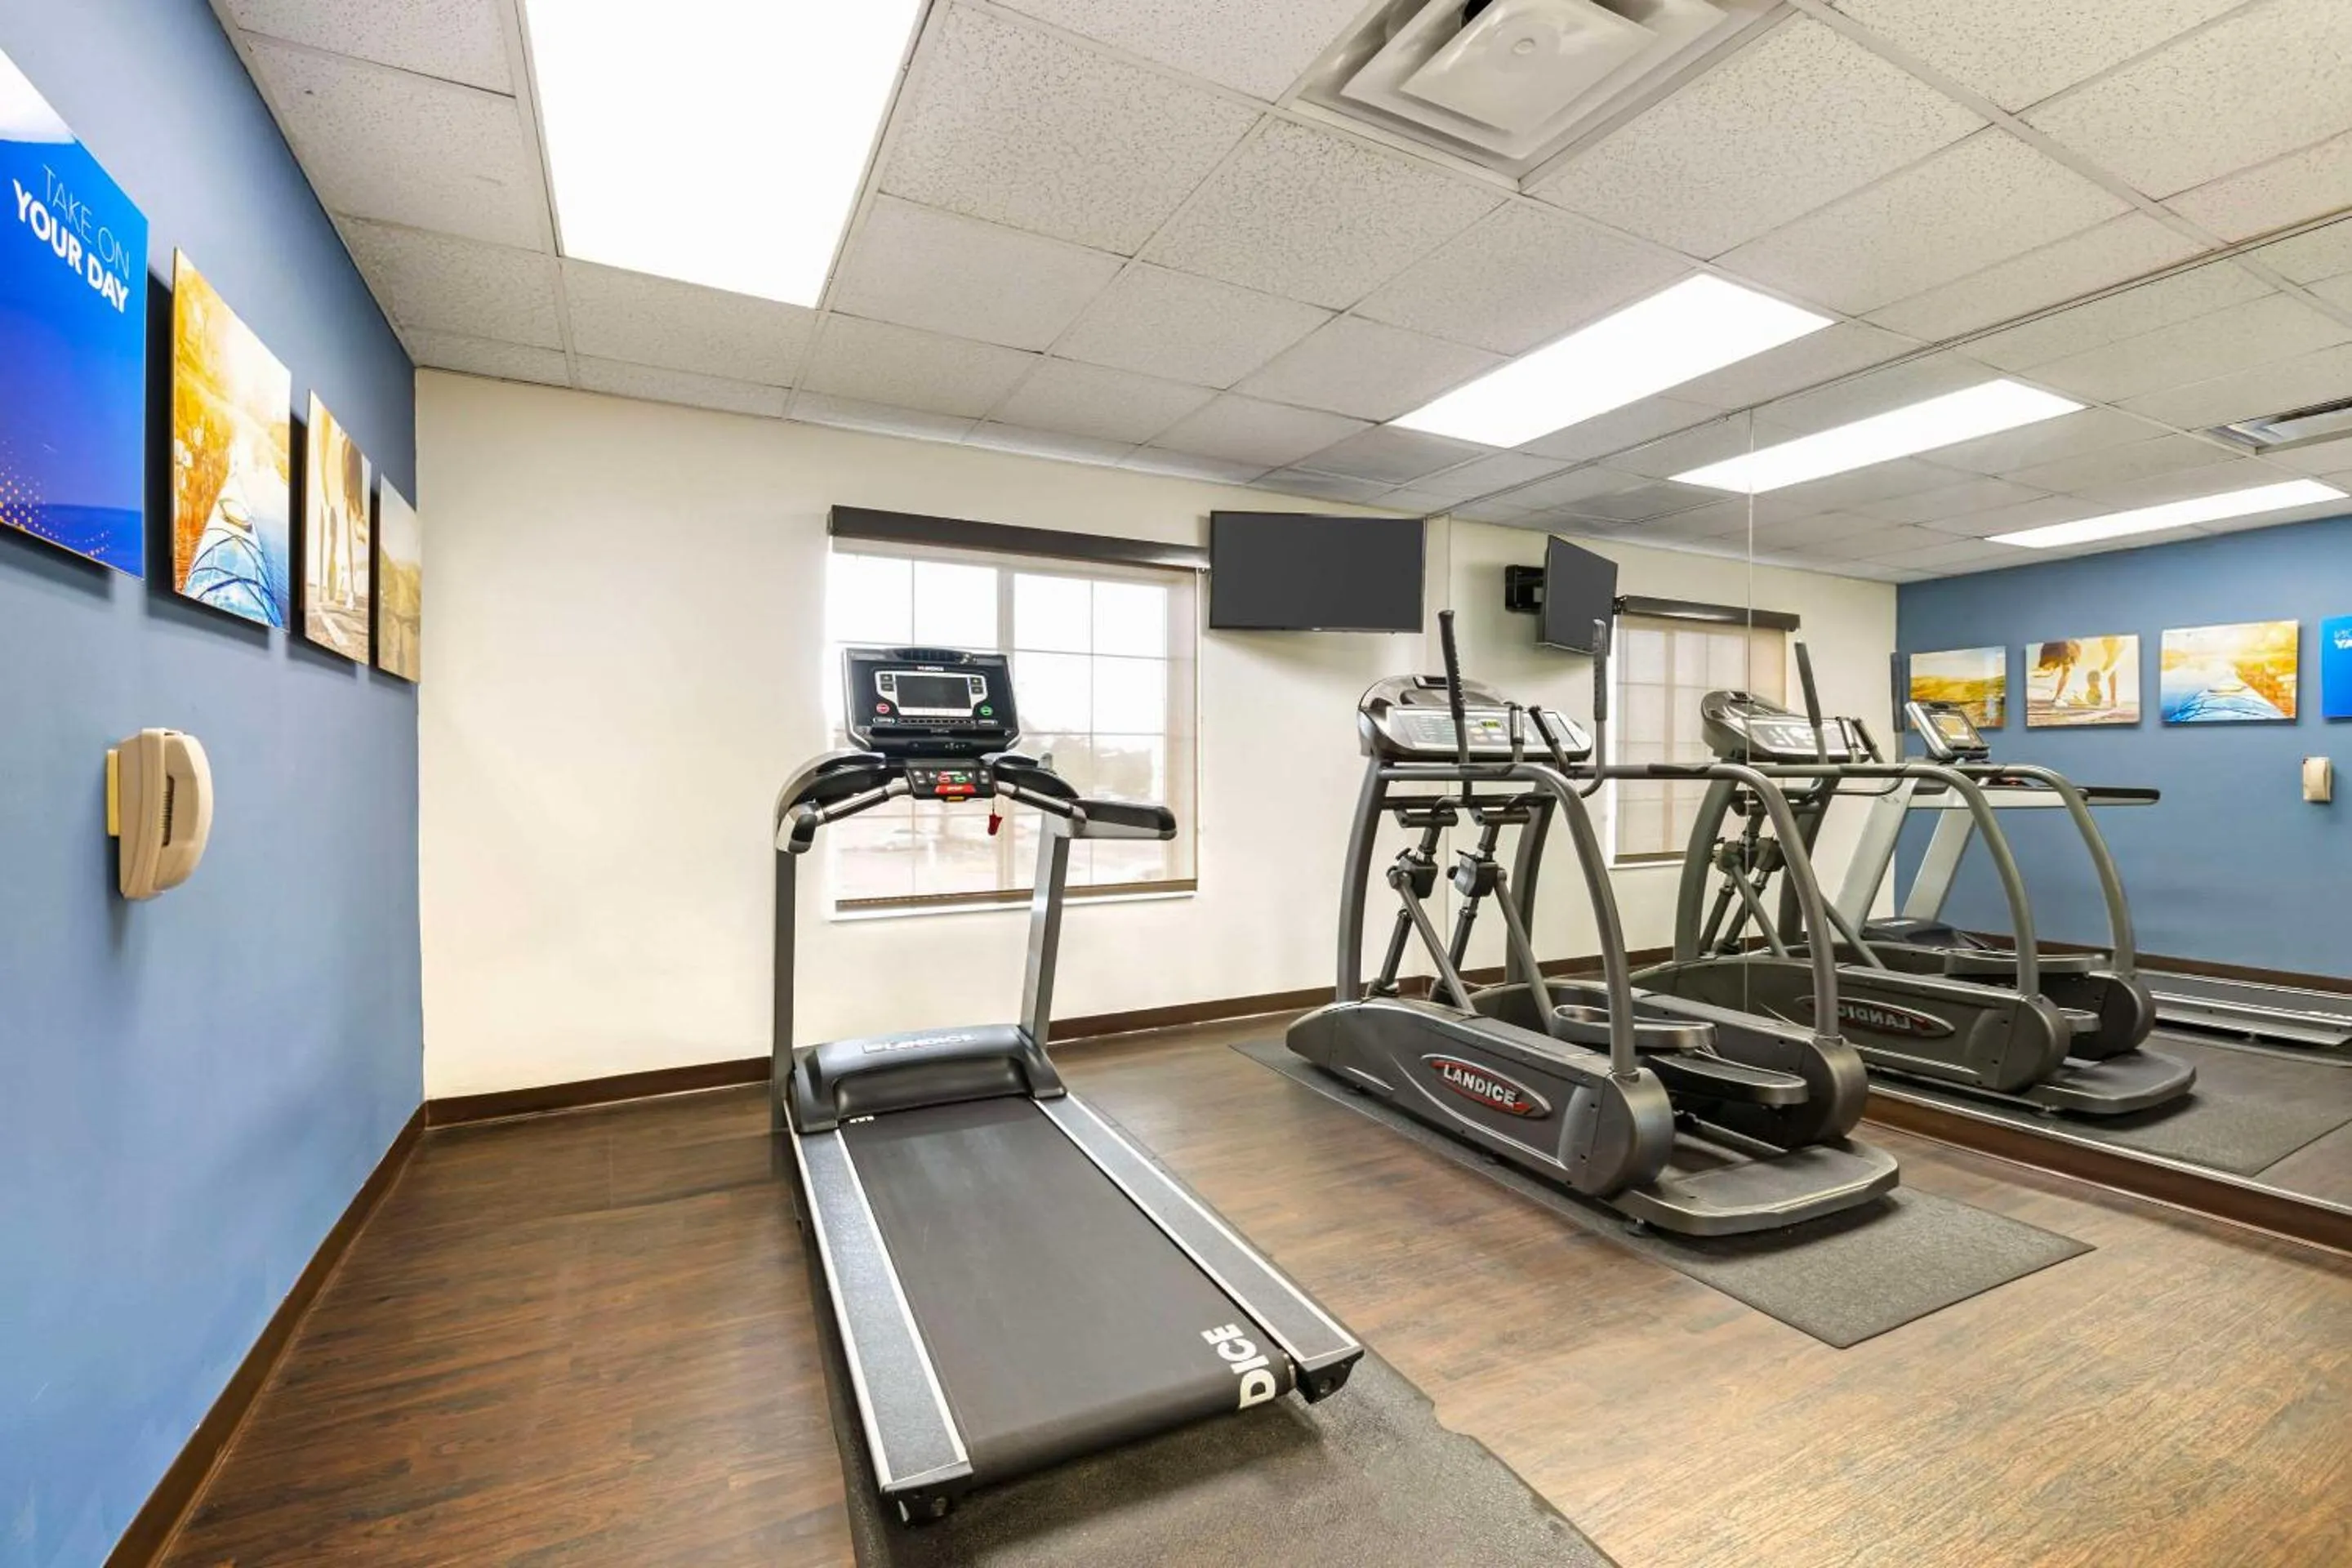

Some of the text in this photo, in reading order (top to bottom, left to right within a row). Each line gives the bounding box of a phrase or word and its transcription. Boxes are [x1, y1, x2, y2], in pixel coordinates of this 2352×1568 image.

[13, 178, 130, 314] YOUR DAY
[42, 163, 130, 281] TAKE ON
[1443, 1064, 1517, 1107] LANDICE
[1200, 1322, 1276, 1410] DICE
